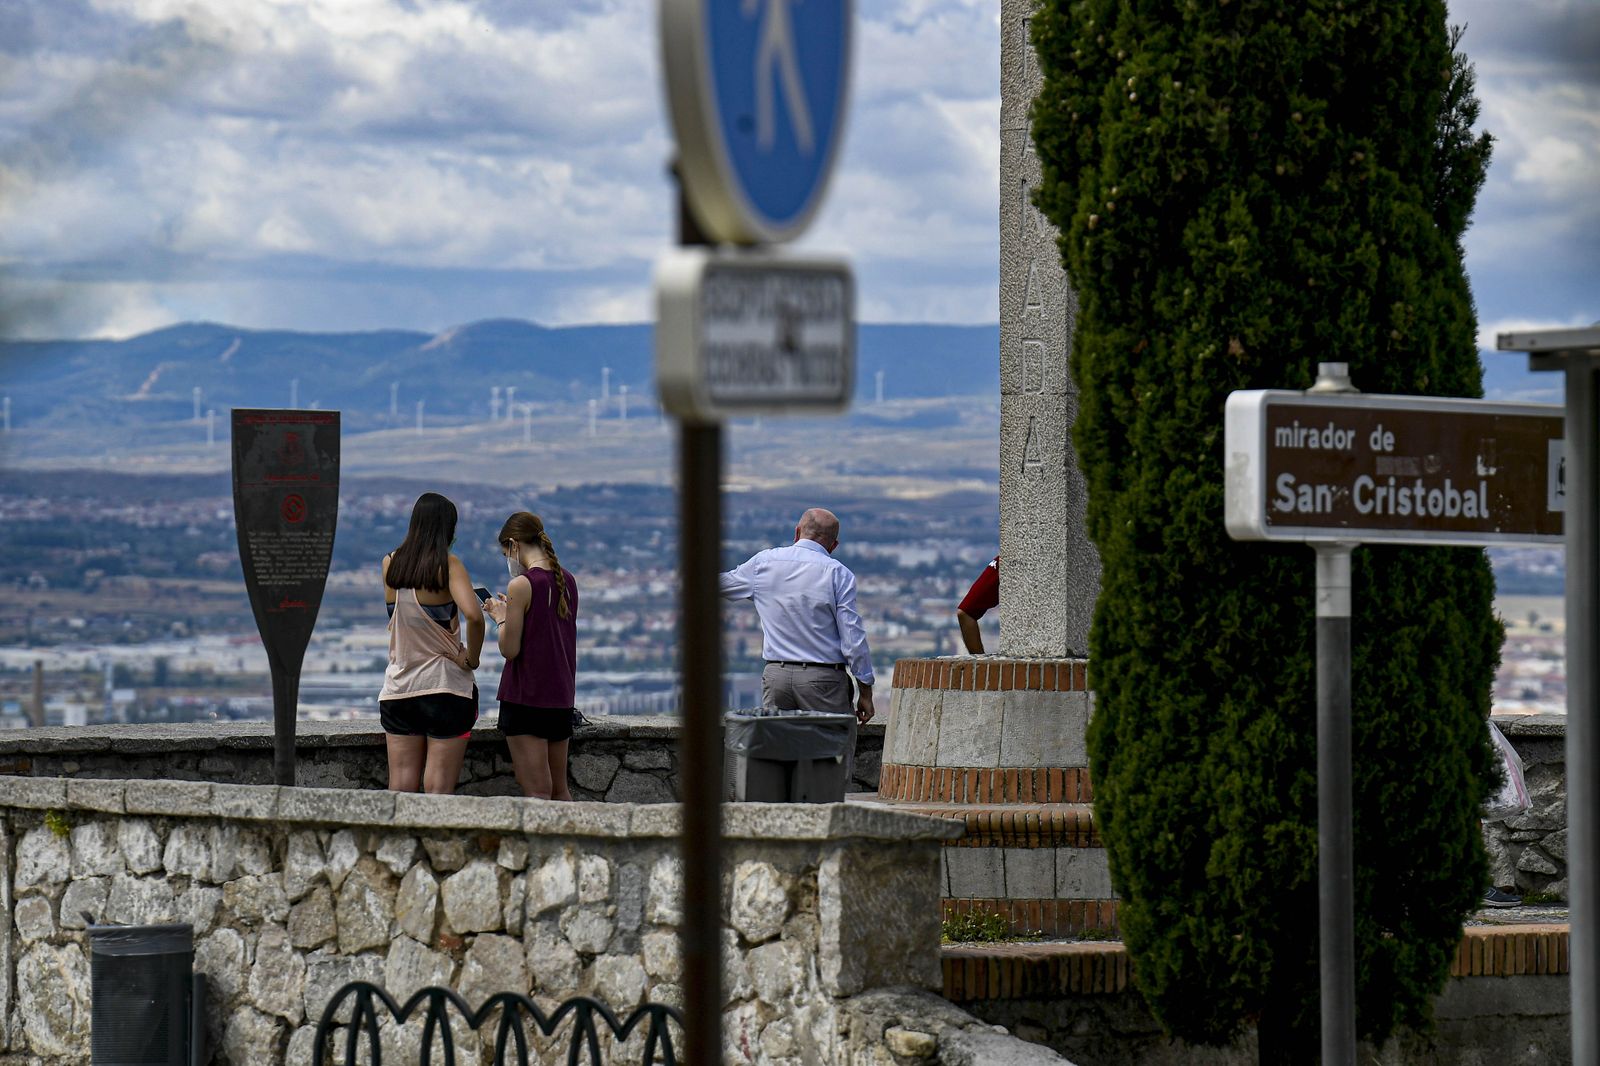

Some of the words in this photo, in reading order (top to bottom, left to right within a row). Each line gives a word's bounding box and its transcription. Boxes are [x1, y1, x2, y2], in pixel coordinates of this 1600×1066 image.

[1275, 421, 1355, 450] mirador
[1370, 424, 1395, 451] de
[1274, 473, 1332, 513] San
[1353, 475, 1489, 519] Cristobal
